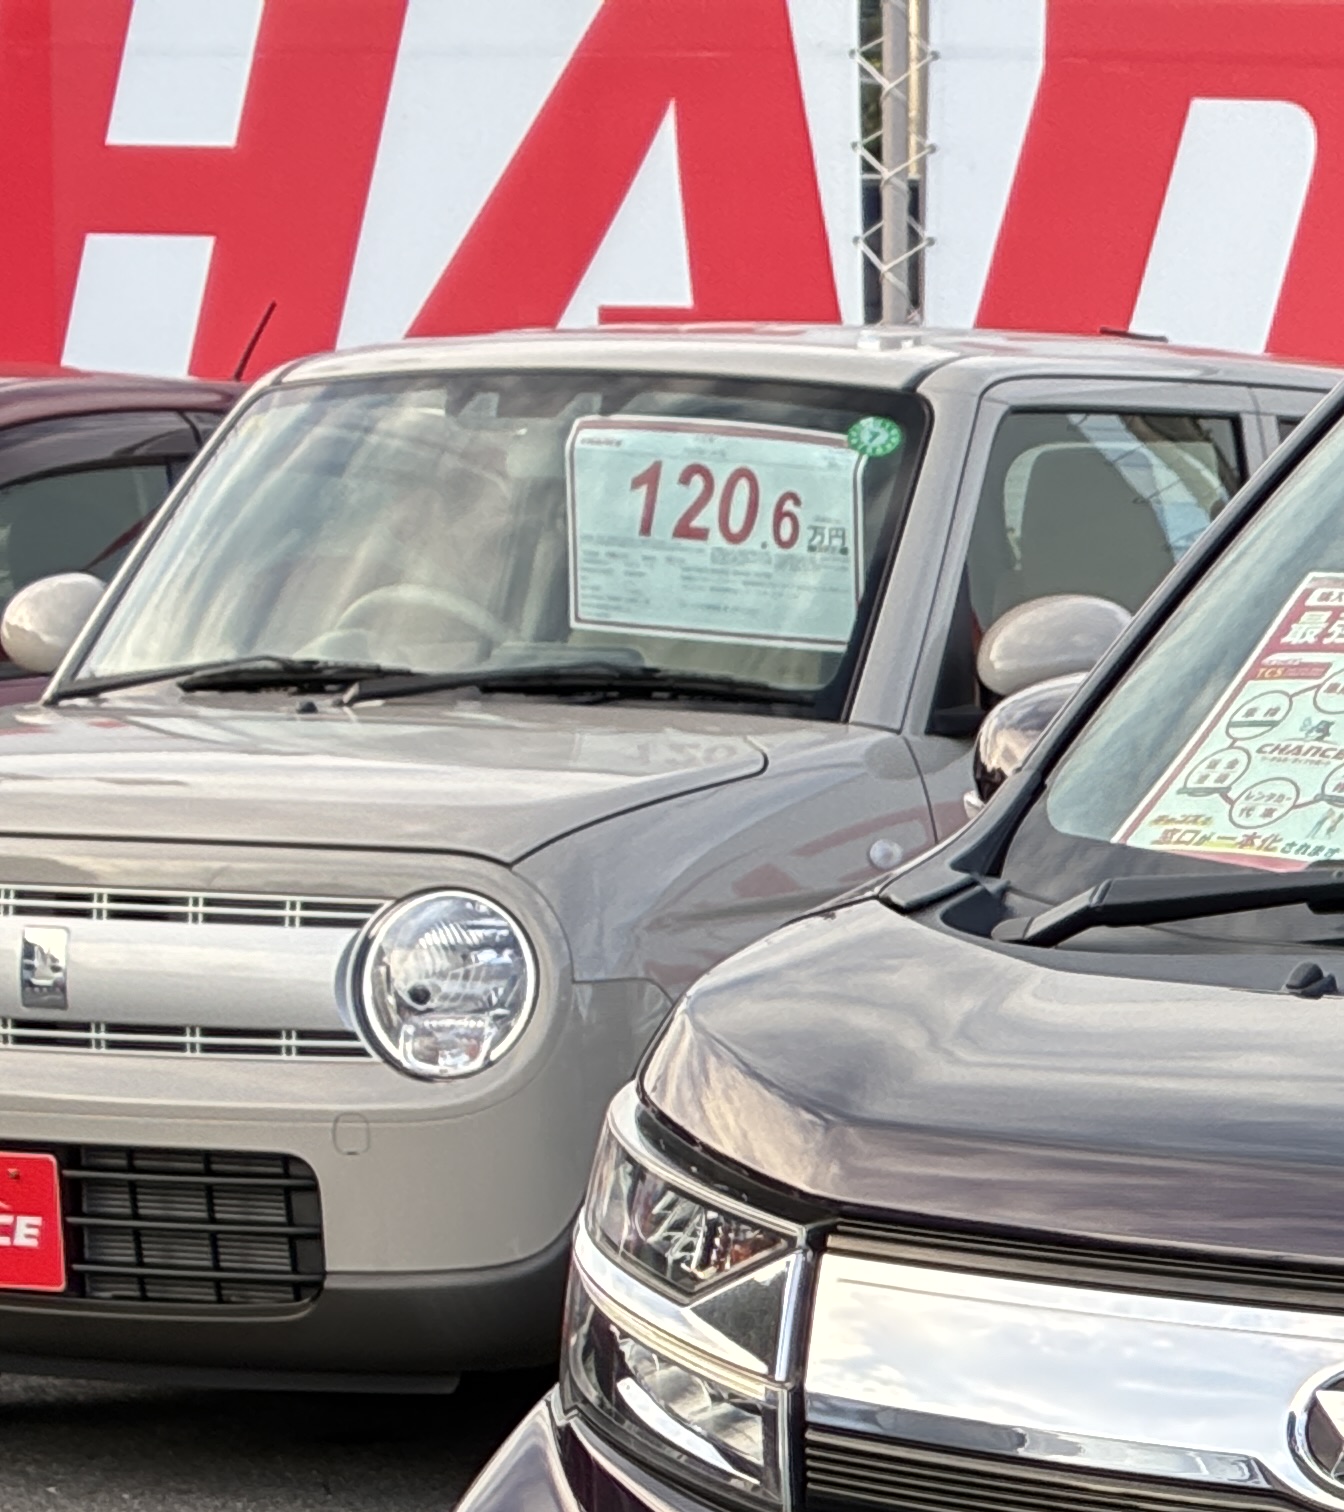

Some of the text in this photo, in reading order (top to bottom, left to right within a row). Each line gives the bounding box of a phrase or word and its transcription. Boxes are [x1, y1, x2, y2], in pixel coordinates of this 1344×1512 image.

[807, 525, 847, 547] 万円
[1244, 789, 1292, 804] レンタカー
